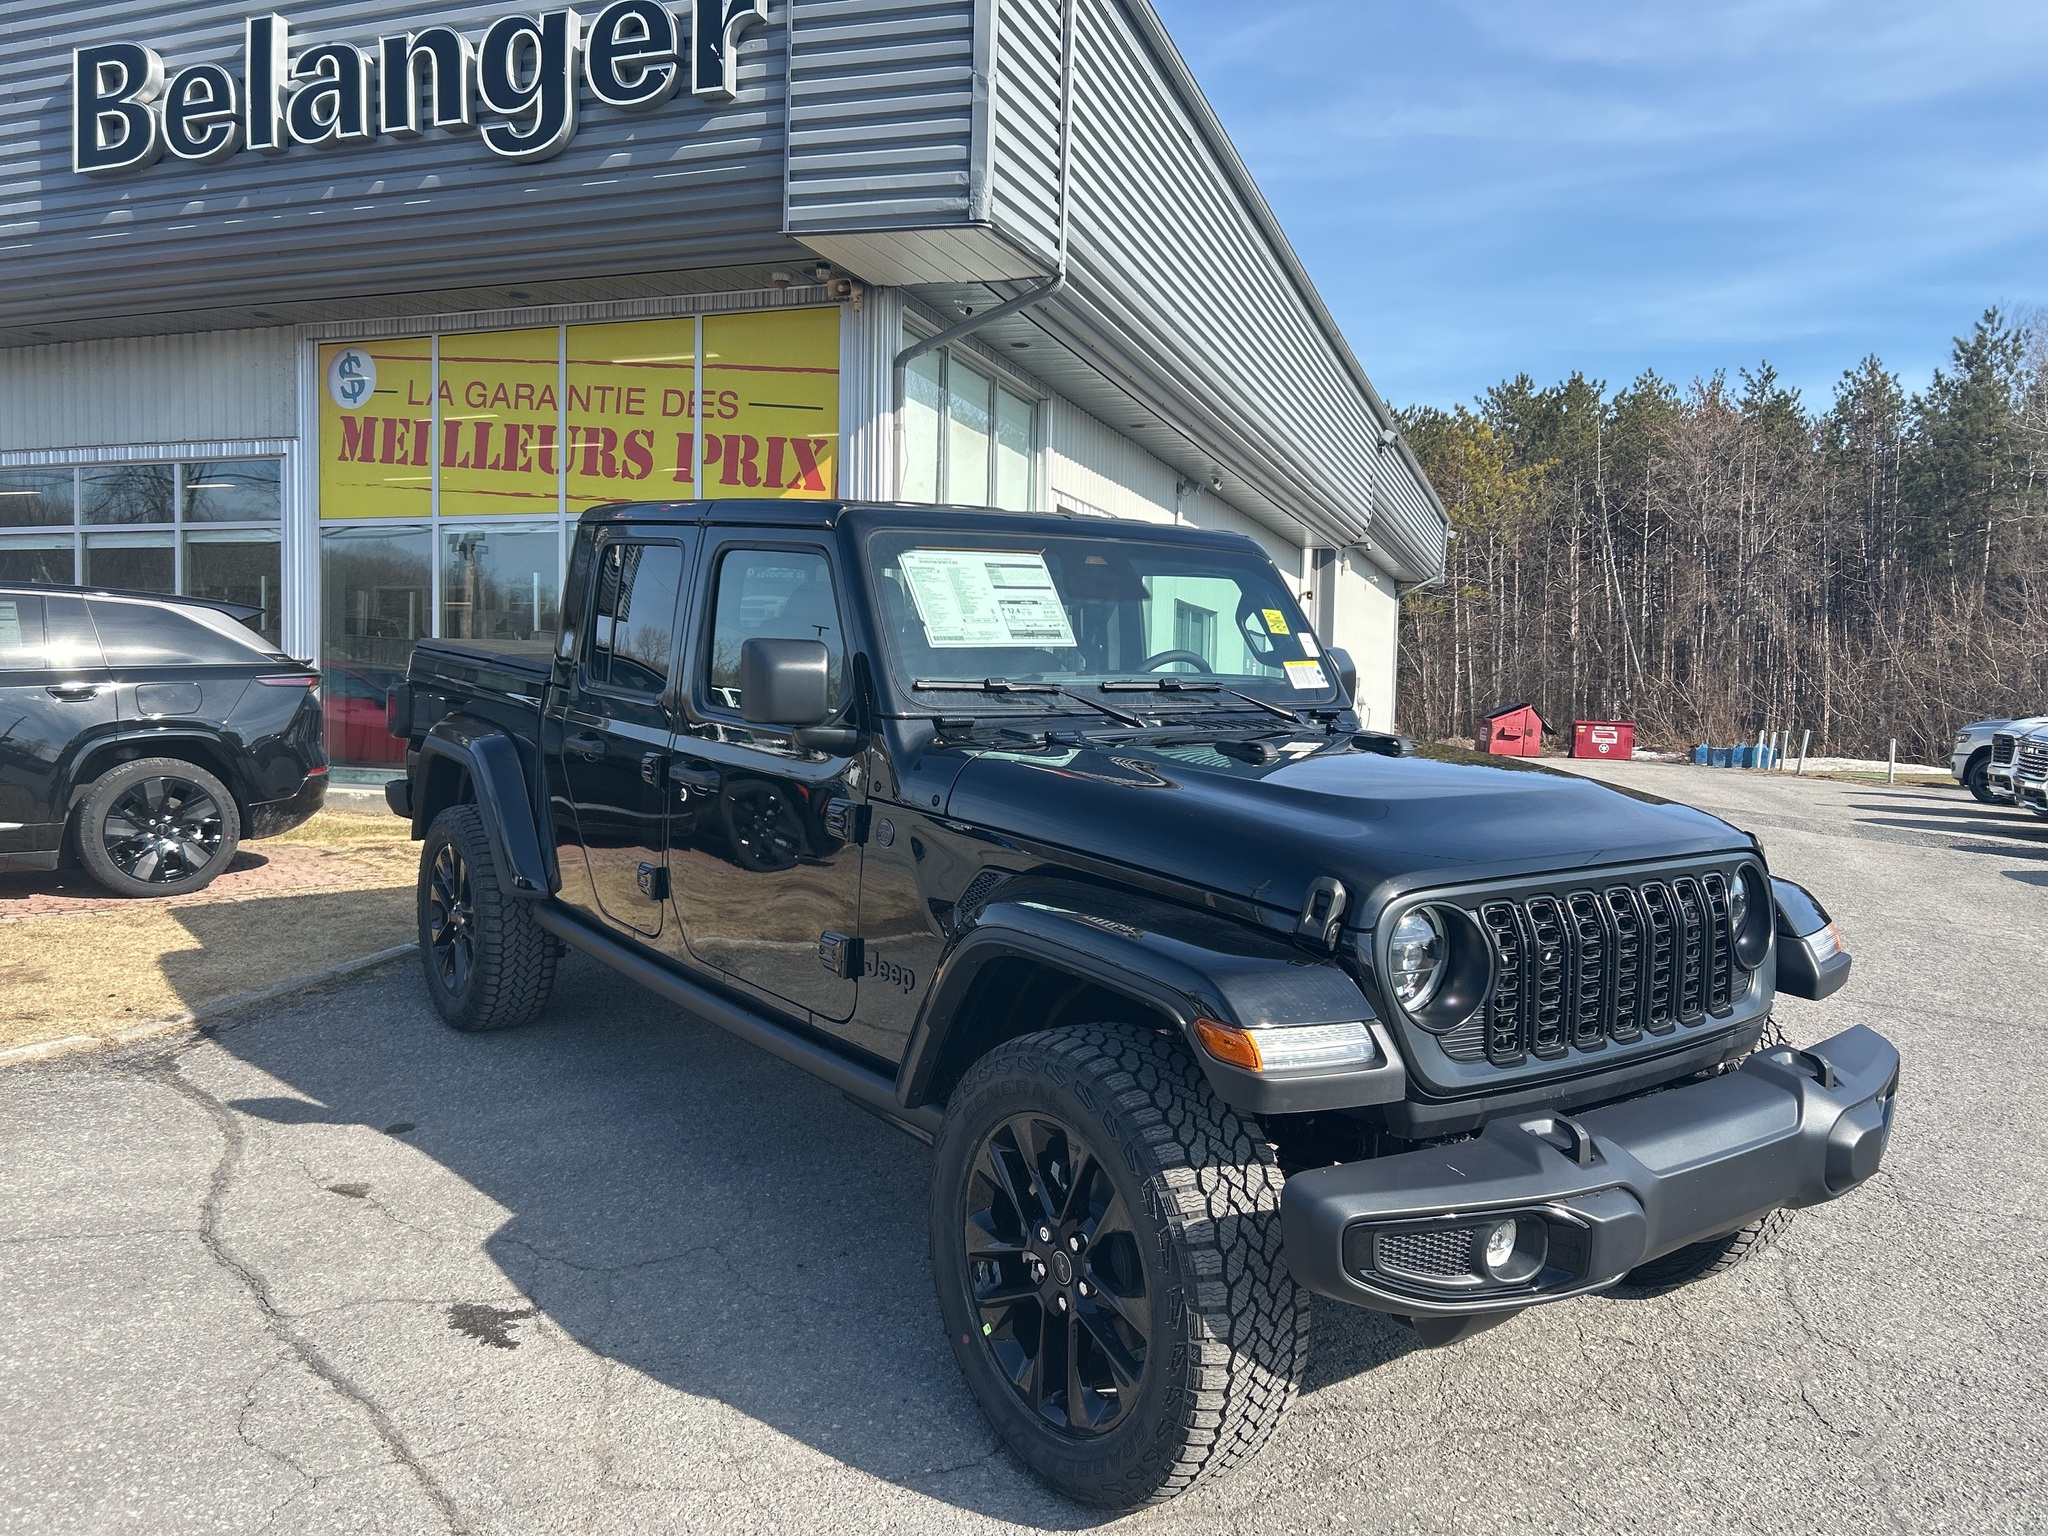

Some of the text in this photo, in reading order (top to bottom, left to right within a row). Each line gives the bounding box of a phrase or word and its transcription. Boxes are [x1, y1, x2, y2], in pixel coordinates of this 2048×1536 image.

[72, 0, 767, 176] Belanger
[407, 379, 739, 420] LA GARANTIE DES
[337, 415, 829, 491] MEILLEURS PRIX
[864, 950, 915, 994] Jeep
[963, 1079, 1064, 1121] GENERAL
